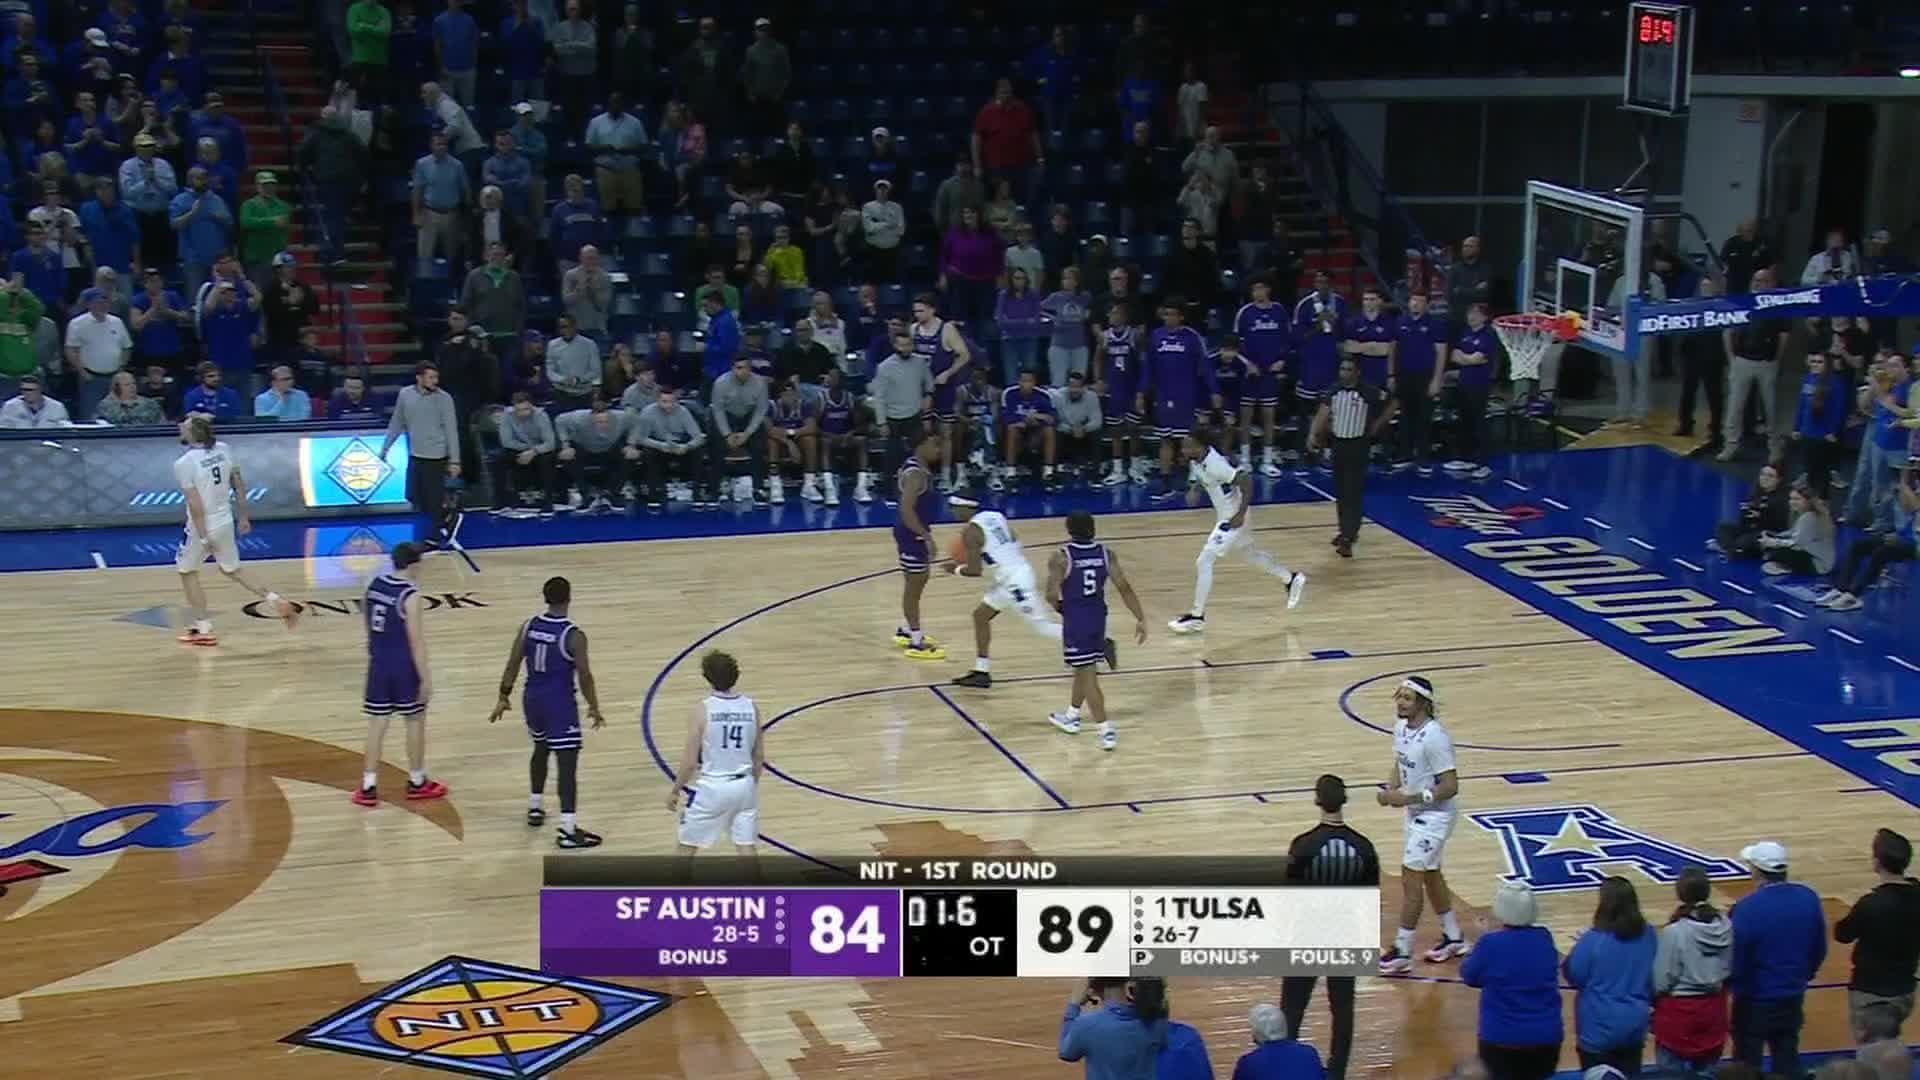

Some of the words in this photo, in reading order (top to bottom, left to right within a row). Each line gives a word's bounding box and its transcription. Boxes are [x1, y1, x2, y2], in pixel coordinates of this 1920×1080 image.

[1703, 310, 1750, 327] BANK
[211, 466, 222, 485] 9
[1082, 568, 1098, 596] 5
[1462, 536, 1818, 660] GOLDEN
[371, 603, 387, 633] 6
[534, 643, 548, 673] 11
[722, 725, 743, 749] 14
[390, 998, 580, 1037] NIT
